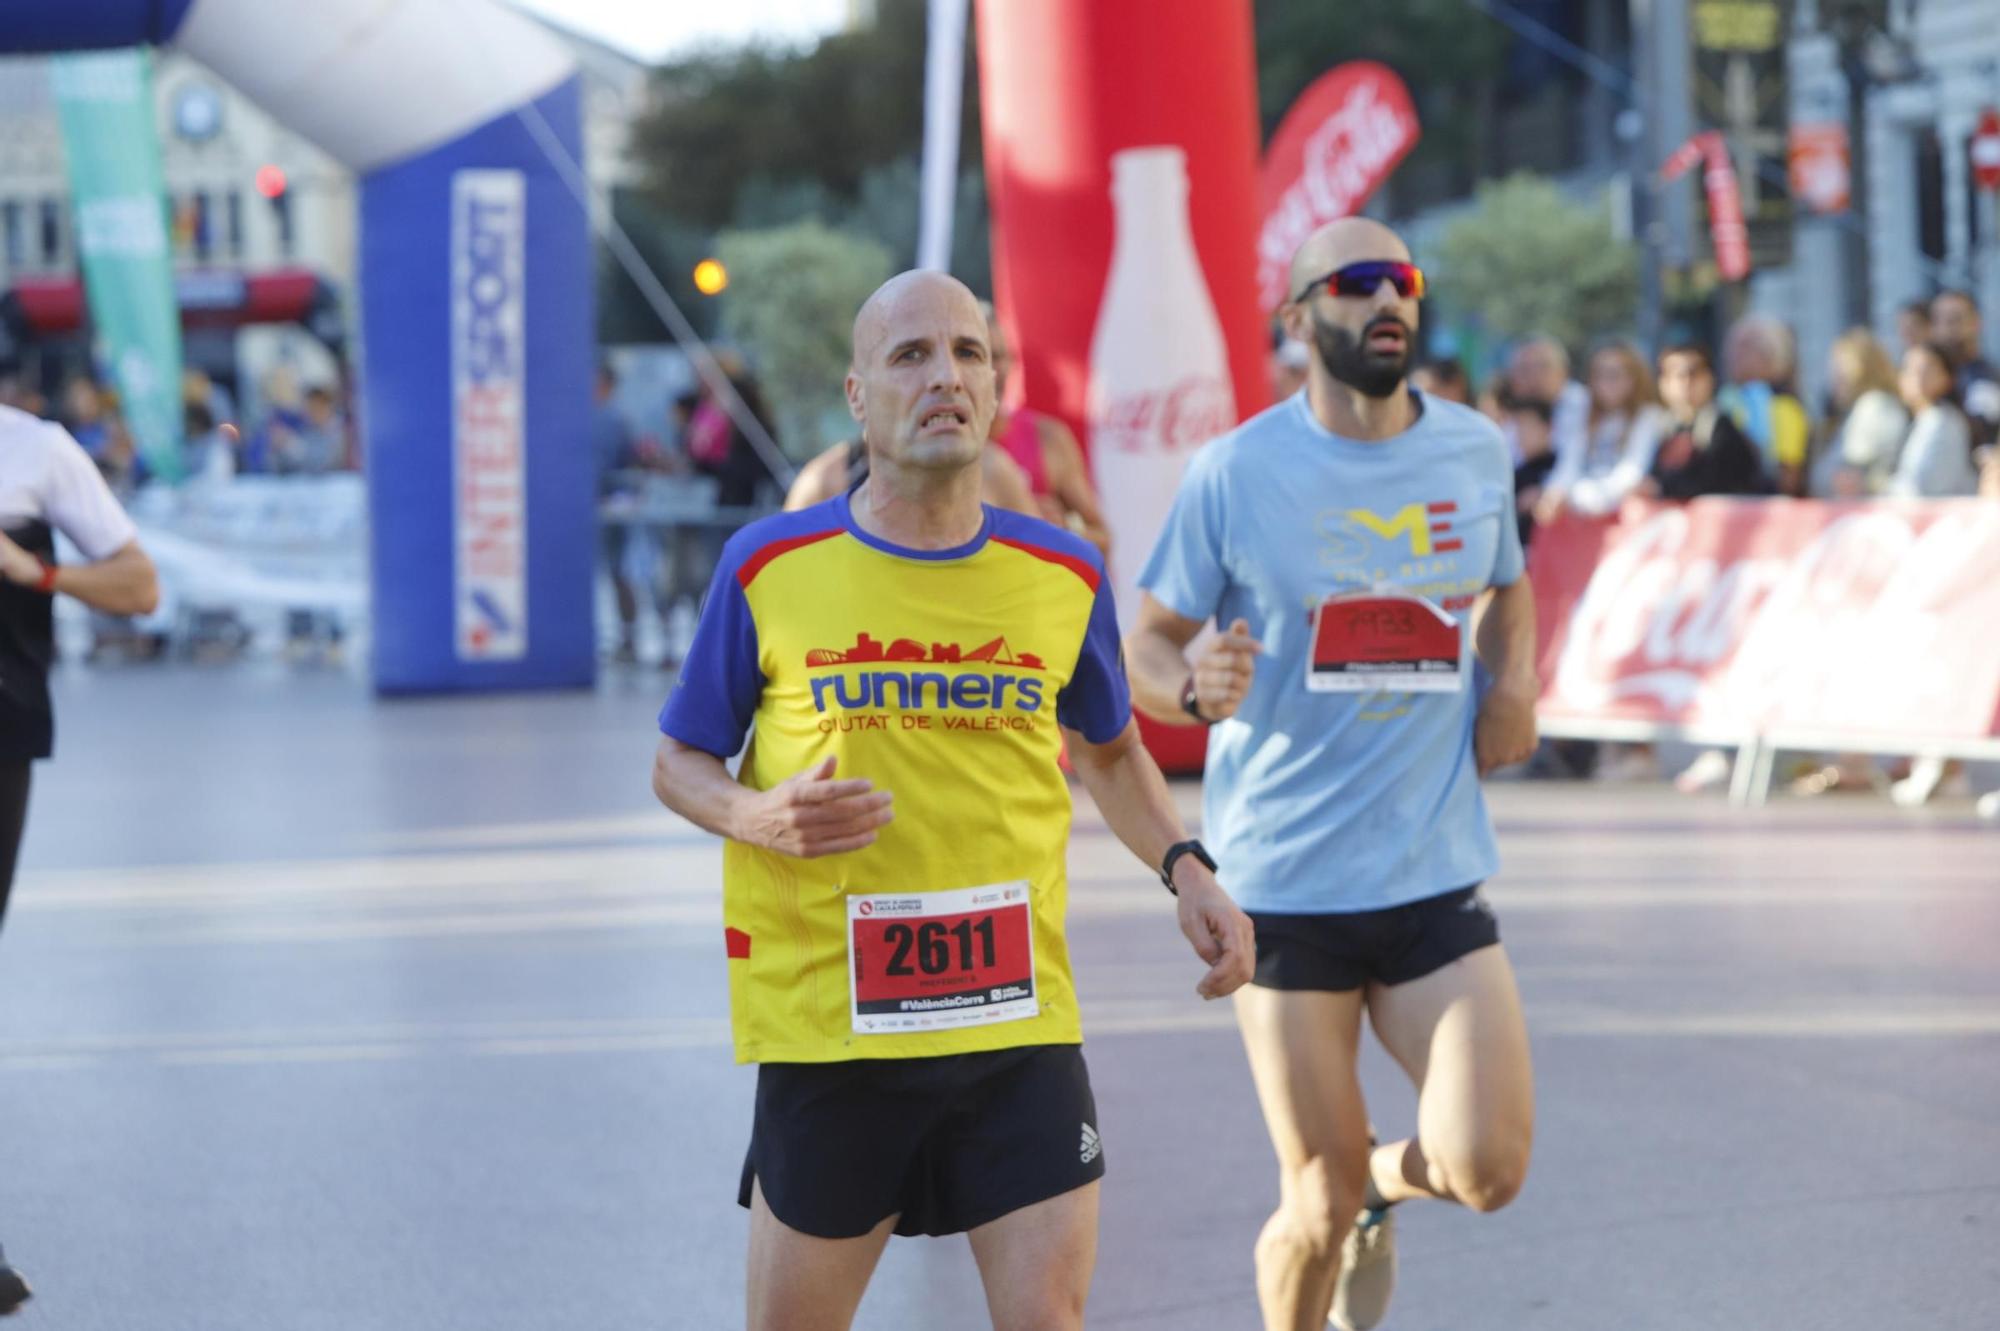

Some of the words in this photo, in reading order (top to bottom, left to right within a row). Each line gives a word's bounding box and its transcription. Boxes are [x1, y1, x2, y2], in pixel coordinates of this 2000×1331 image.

[463, 195, 518, 580] INTERSPORT
[810, 671, 1043, 712] runners
[818, 715, 891, 733] CIUTAT
[902, 715, 931, 730] DE
[884, 915, 996, 976] 2611
[900, 995, 985, 1011] #ValènciaCorre
